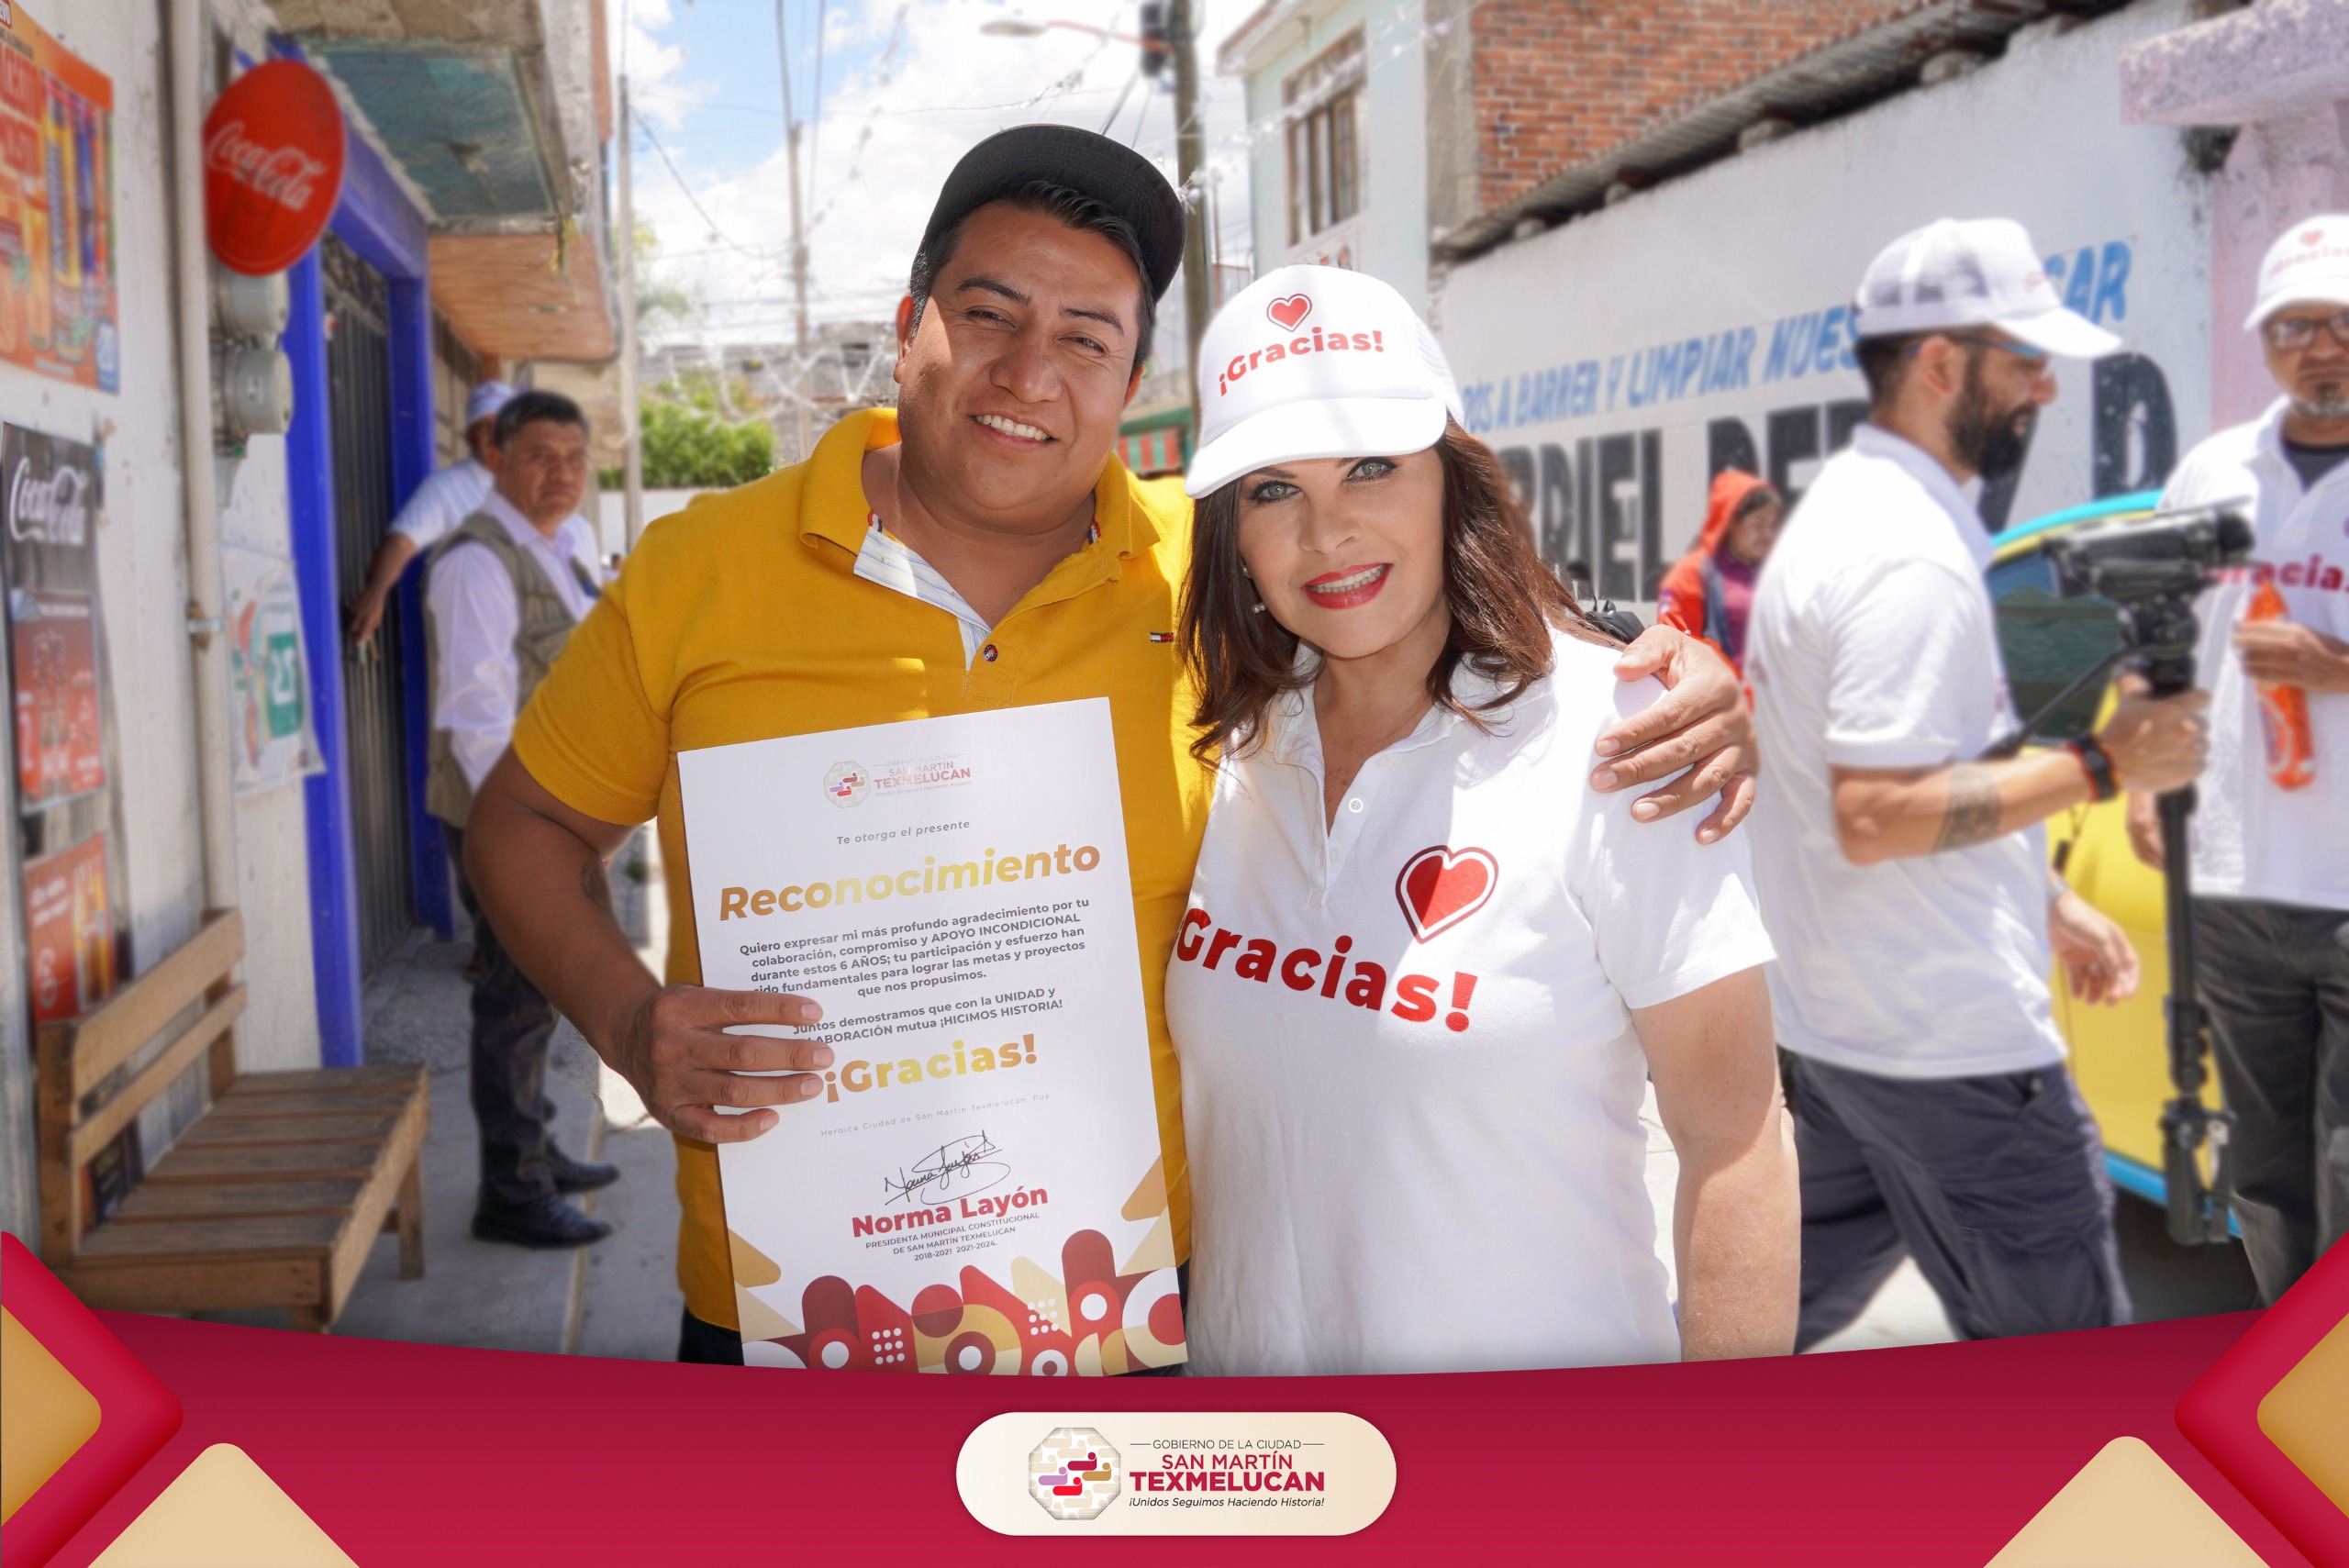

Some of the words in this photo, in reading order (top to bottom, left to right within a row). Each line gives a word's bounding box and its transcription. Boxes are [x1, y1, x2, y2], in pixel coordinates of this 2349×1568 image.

[1219, 326, 1385, 396] ¡Gracias!
[1515, 359, 1601, 428] BARRER
[1606, 353, 1625, 413] Y
[1627, 326, 1757, 407] LIMPIAR
[874, 767, 971, 789] TEXMELUCAN
[837, 835, 850, 845] Te
[854, 830, 896, 841] otorga
[901, 827, 911, 837] el
[916, 820, 971, 837] presente
[719, 843, 1100, 921] Reconocimiento
[740, 941, 781, 956] Quiero
[784, 935, 839, 951] expresar
[842, 929, 858, 941] mi
[862, 927, 888, 940] más
[891, 917, 949, 937] profundo
[952, 905, 1050, 927] agradecimiento
[1052, 901, 1074, 917] por
[1076, 898, 1089, 908] tu
[752, 948, 837, 968] colaboración,
[839, 936, 918, 957] compromiso
[920, 936, 929, 947] y
[931, 928, 976, 943] APOYO
[979, 913, 1081, 936] INCONDICIONAL
[751, 969, 800, 982] durante
[803, 964, 837, 976] estos
[840, 961, 848, 971] 6
[851, 955, 891, 969] AÑOS;
[894, 952, 907, 962] tu
[910, 940, 992, 962] participación
[995, 939, 1002, 950] y
[1006, 931, 1058, 946] esfuerzo
[1061, 927, 1085, 939] han
[782, 972, 878, 992] fundamentales
[881, 968, 908, 980] para
[912, 962, 949, 974] lograr
[952, 958, 970, 968] las
[973, 952, 1011, 965] metas
[1014, 951, 1021, 961] y
[1024, 940, 1085, 959] proyectos
[1176, 907, 1478, 1032] Gracias!
[857, 984, 882, 998] que
[885, 982, 907, 993] nos
[910, 970, 986, 991] propusimos.
[793, 1021, 836, 1035] Juntos
[839, 1007, 925, 1028] demostramos
[929, 1004, 952, 1016] que
[955, 998, 978, 1010] con
[981, 996, 992, 1006] la
[995, 988, 1045, 1004] UNIDAD
[1048, 988, 1056, 998] y
[896, 1019, 937, 1033] mutua
[940, 1009, 997, 1029] ¡HICIMOS
[1001, 999, 1063, 1018] HISTORIA!
[824, 1033, 1038, 1104] ¡Gracias!
[821, 1124, 858, 1136] Heroica
[863, 1118, 896, 1129] Ciudad
[900, 1116, 912, 1124] de
[916, 1112, 933, 1121] San
[852, 1204, 952, 1238] Norma
[960, 1185, 1049, 1218] Layón
[865, 1234, 918, 1249] PRESIDENTA
[920, 1226, 967, 1240] MUNICIPAL
[968, 1212, 1040, 1230] CONSTITUCIONAL
[893, 1247, 906, 1255] DE
[907, 1243, 925, 1252] SAN
[926, 1237, 959, 1250] MARTÍN
[961, 1226, 1016, 1242] TEXMELUCAN
[914, 1248, 952, 1262] 2018-2021
[956, 1241, 998, 1253] 2021-2024.
